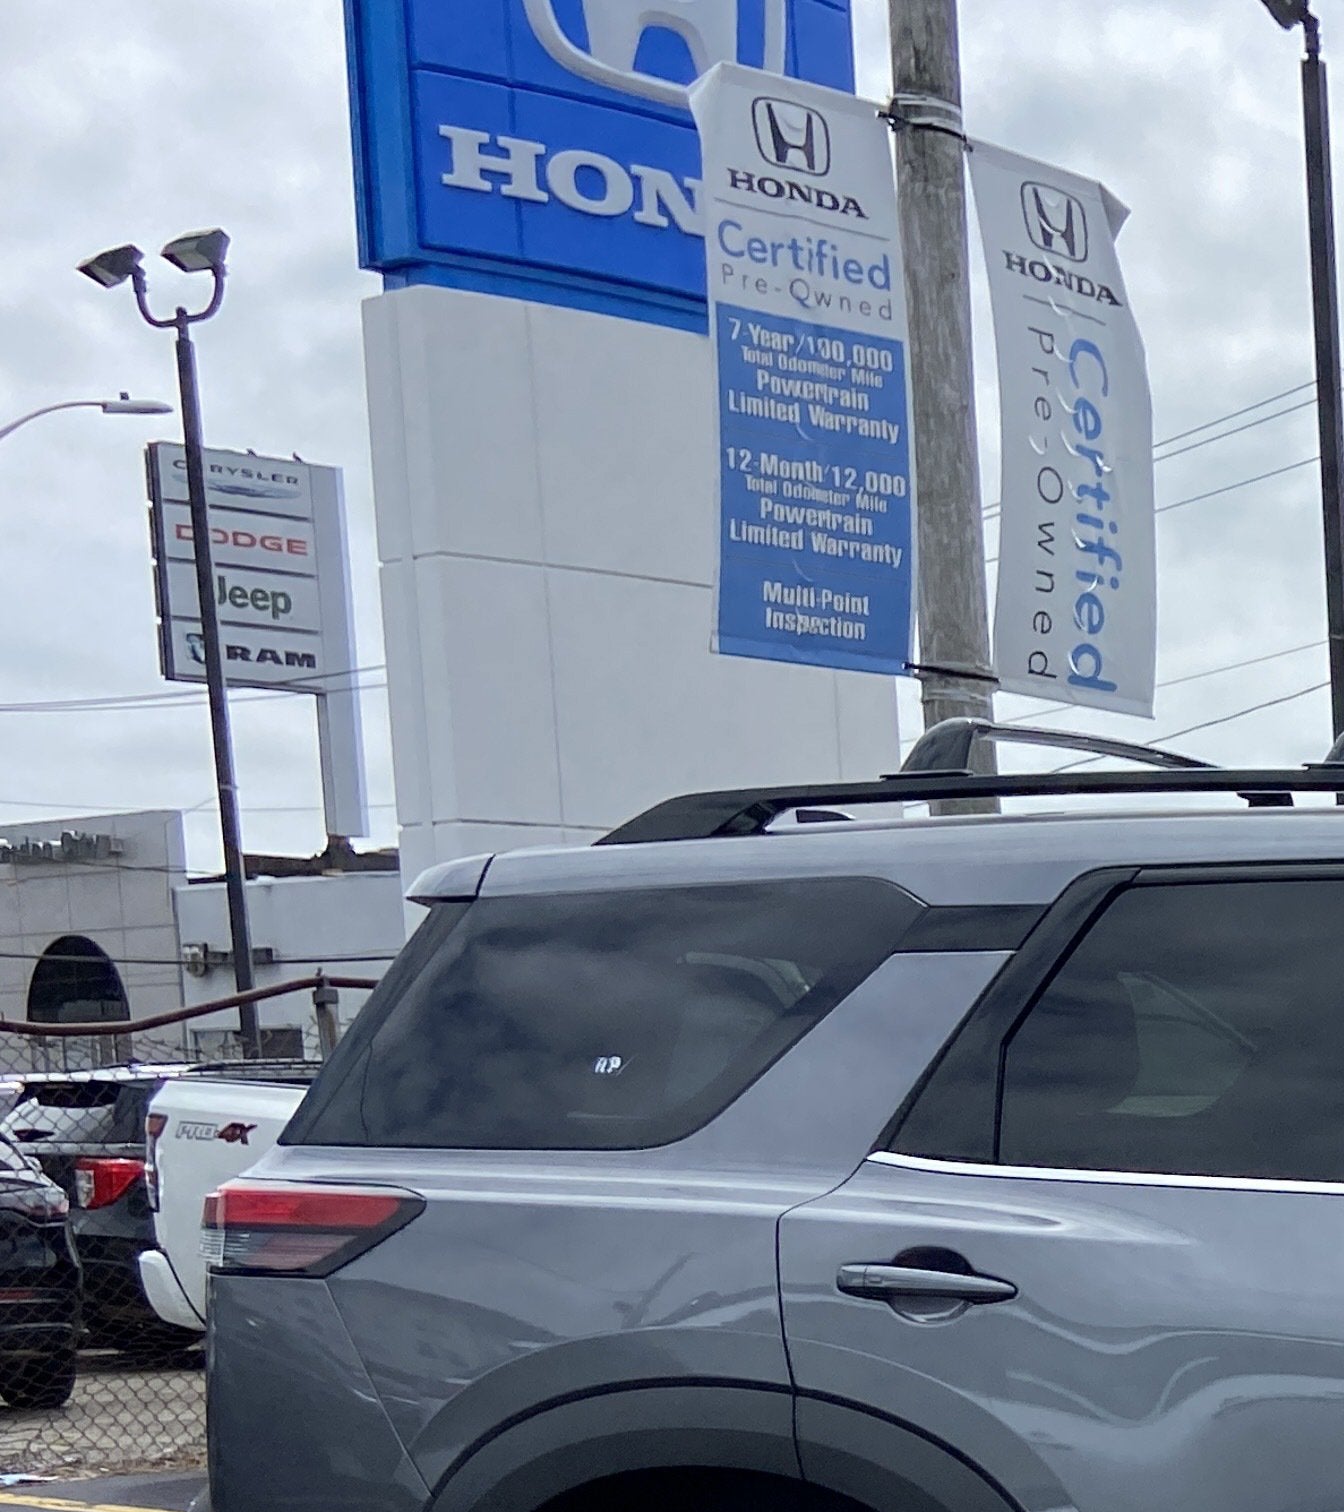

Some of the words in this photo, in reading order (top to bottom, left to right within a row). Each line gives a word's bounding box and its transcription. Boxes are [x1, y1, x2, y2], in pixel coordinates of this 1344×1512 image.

[438, 125, 703, 237] HON
[727, 168, 870, 220] HONDA
[718, 219, 892, 291] Certified
[1002, 249, 1124, 307] HONDA
[741, 345, 773, 367] Total
[851, 368, 883, 388] Mile
[757, 369, 869, 411] Powertrain
[728, 389, 801, 423] Limited
[808, 403, 899, 444] Warranty
[173, 459, 299, 485] CRYSLER
[745, 474, 777, 494] Total
[856, 493, 888, 513] Mile
[760, 497, 873, 536] Powertrain
[1027, 326, 1064, 681] Pre-Owned
[1067, 338, 1122, 693] Certified
[730, 518, 804, 550] Limited
[811, 531, 902, 568] Warranty
[218, 576, 292, 619] Jeep
[763, 581, 870, 616] Multi-Point
[765, 607, 865, 640] Inspection
[226, 644, 316, 668] RAM
